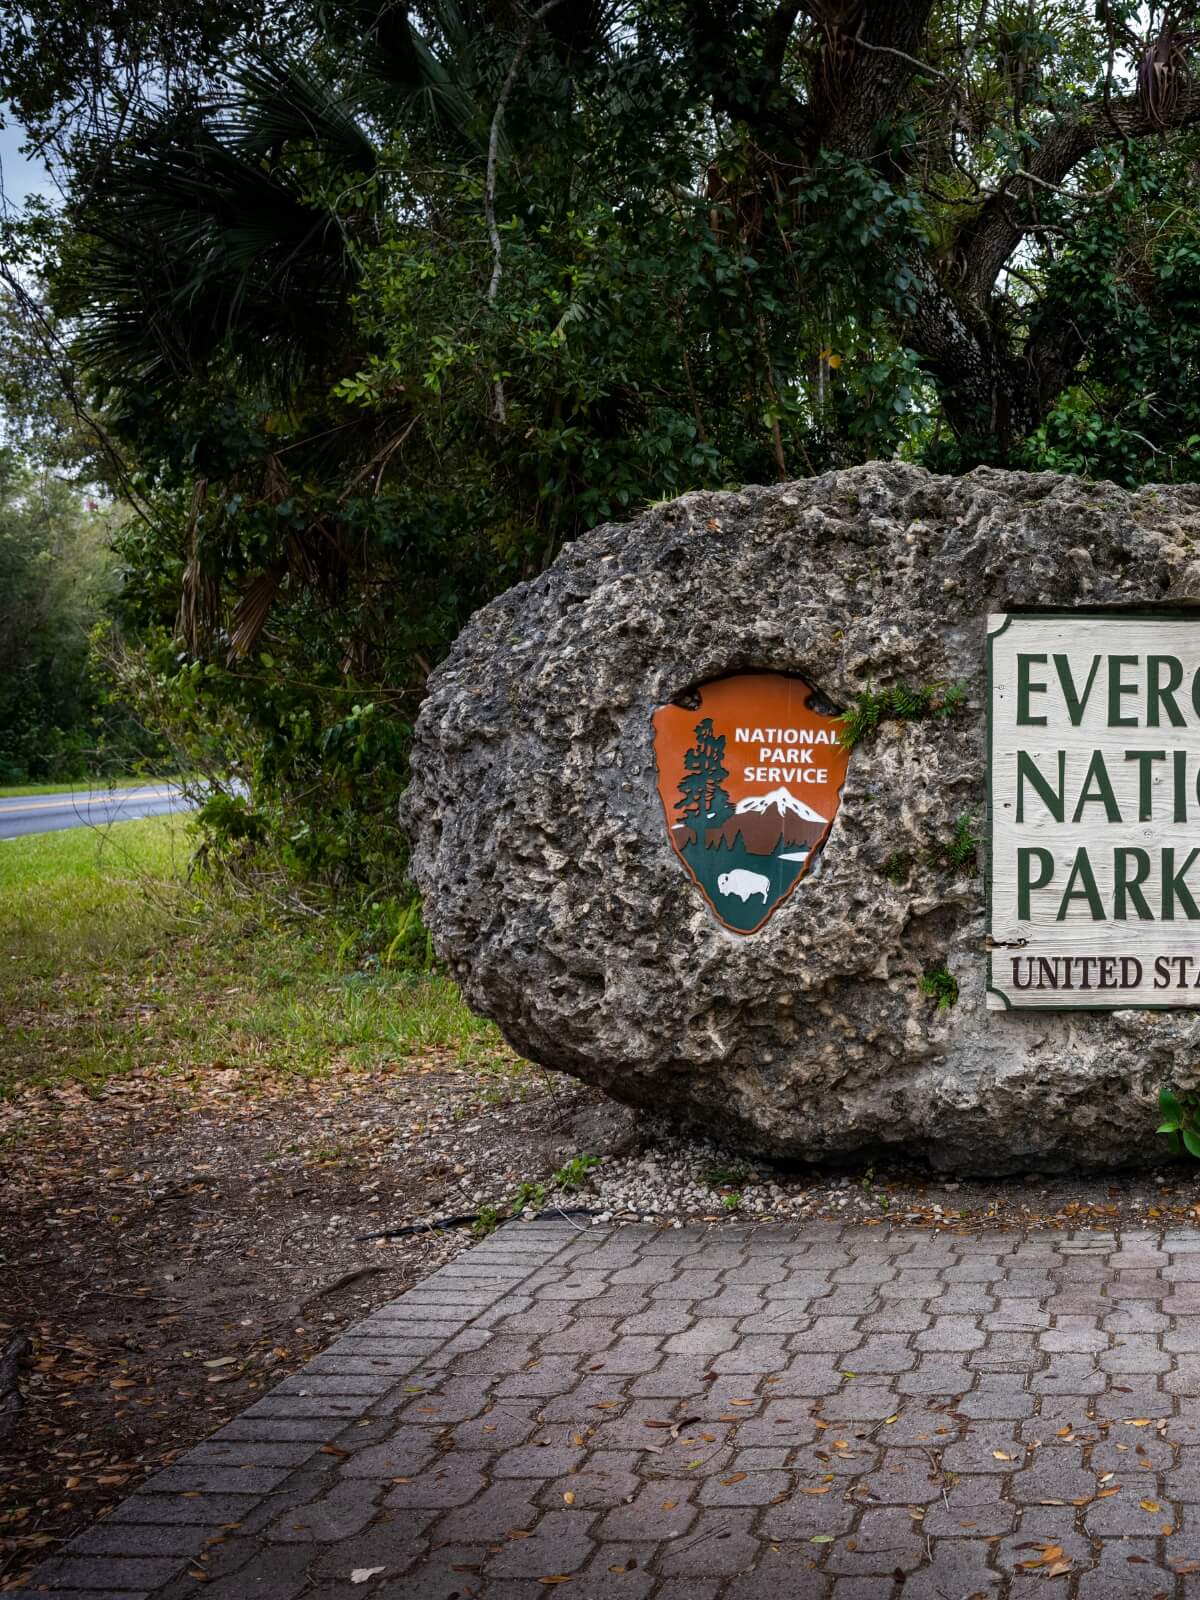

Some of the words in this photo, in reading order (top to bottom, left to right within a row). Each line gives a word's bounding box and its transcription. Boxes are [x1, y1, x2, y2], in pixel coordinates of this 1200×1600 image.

[734, 727, 841, 745] NATIONAL
[759, 748, 814, 764] PARK
[743, 767, 828, 783] SERVICE
[1011, 956, 1143, 989] UNITED
